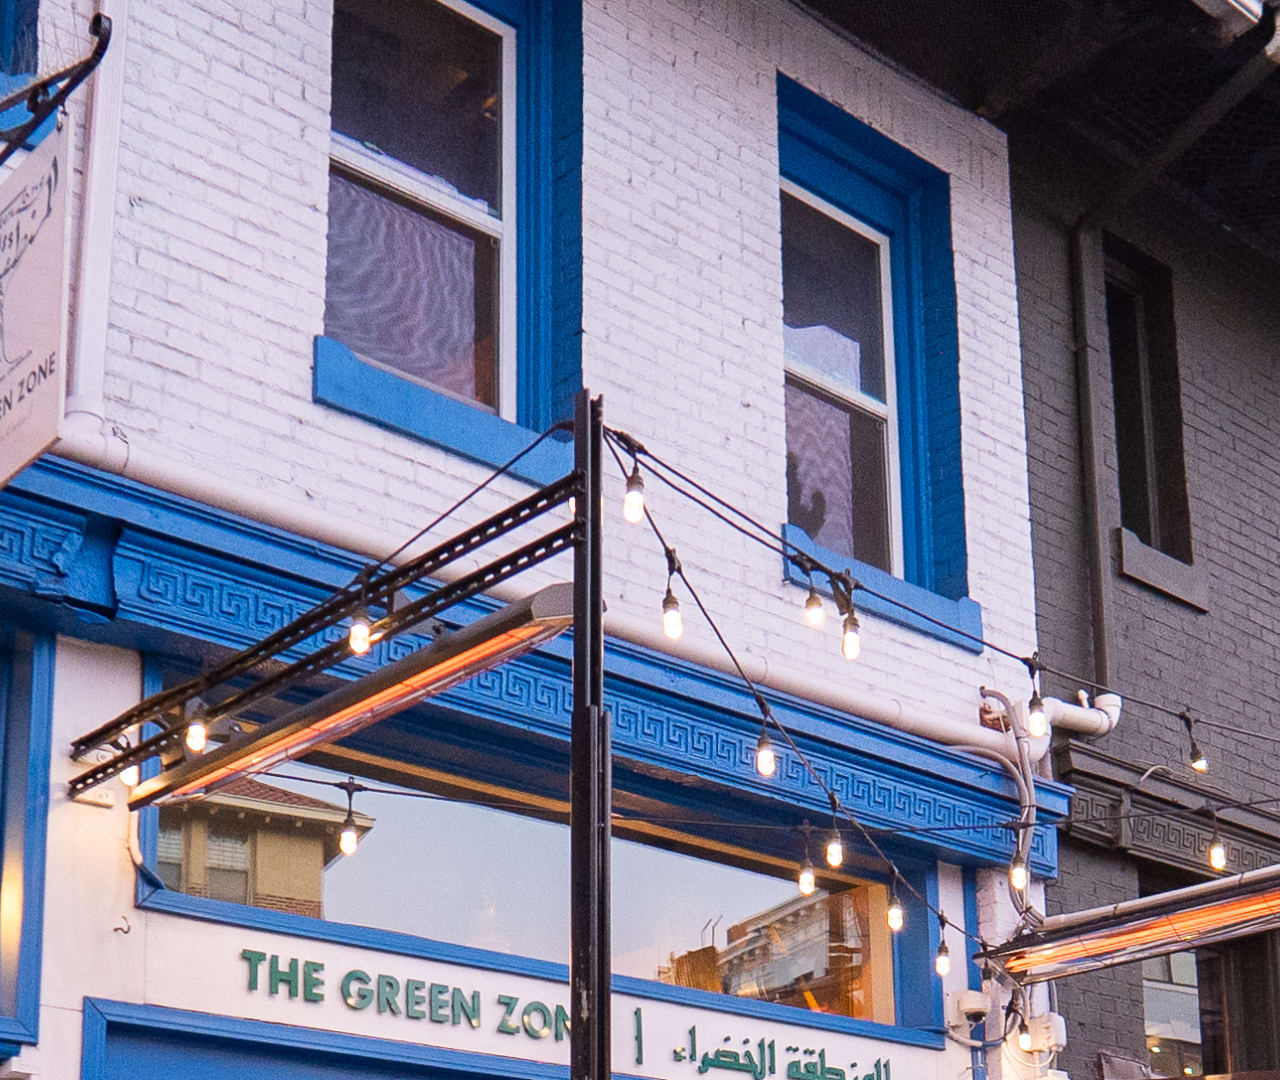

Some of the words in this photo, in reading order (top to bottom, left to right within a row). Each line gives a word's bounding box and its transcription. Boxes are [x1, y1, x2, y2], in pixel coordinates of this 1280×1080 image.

[18, 351, 55, 403] ZONE
[241, 948, 325, 1002] THE
[341, 969, 482, 1029] GREEN
[496, 993, 571, 1042] ZON
